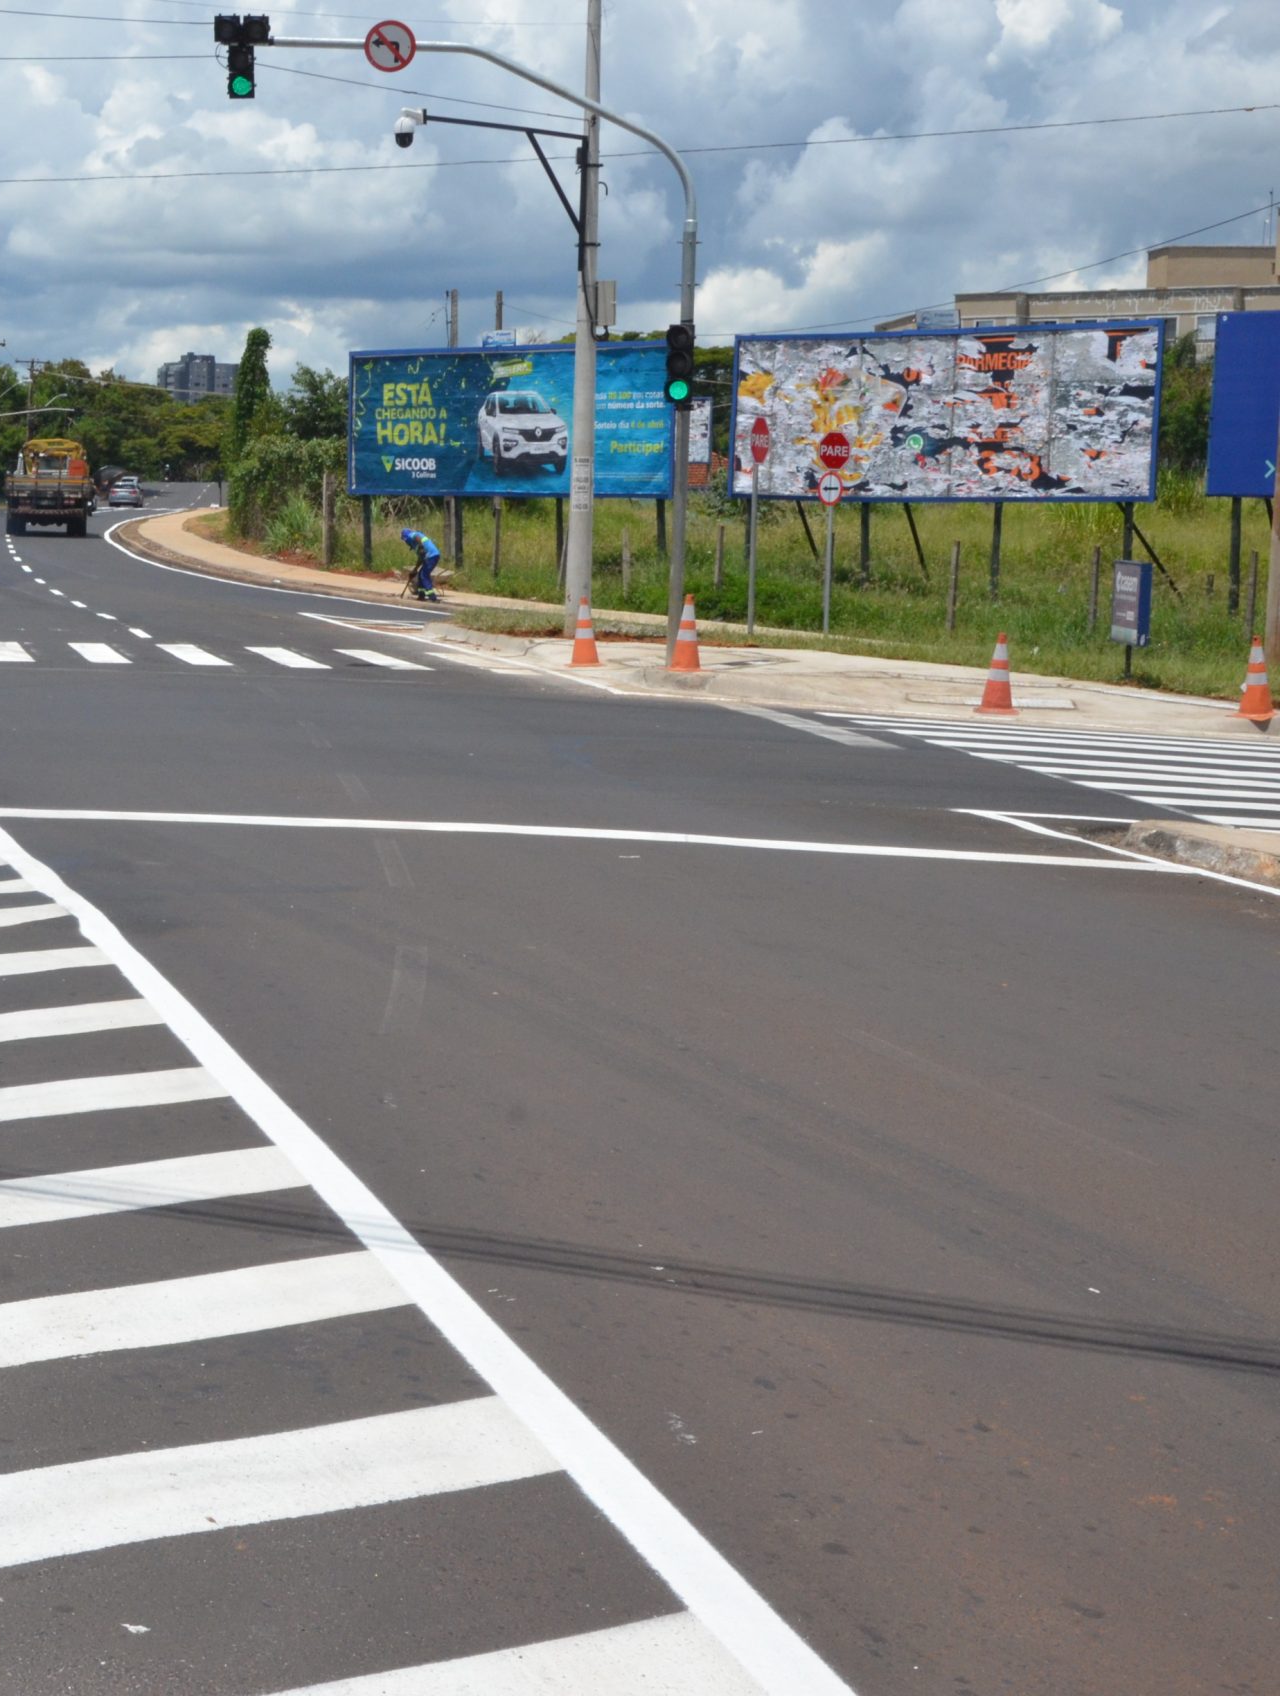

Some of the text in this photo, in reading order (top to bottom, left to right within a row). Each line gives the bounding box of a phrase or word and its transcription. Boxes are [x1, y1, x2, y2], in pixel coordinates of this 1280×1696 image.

[382, 377, 433, 407] ESTÁ
[608, 401, 634, 409] número
[636, 401, 645, 409] da
[376, 407, 447, 420] CHEGANDO A
[376, 421, 446, 446] HORA!
[751, 433, 769, 448] PARE
[610, 440, 664, 456] Participe!
[821, 444, 849, 457] PARE
[394, 457, 437, 471] SICOOB
